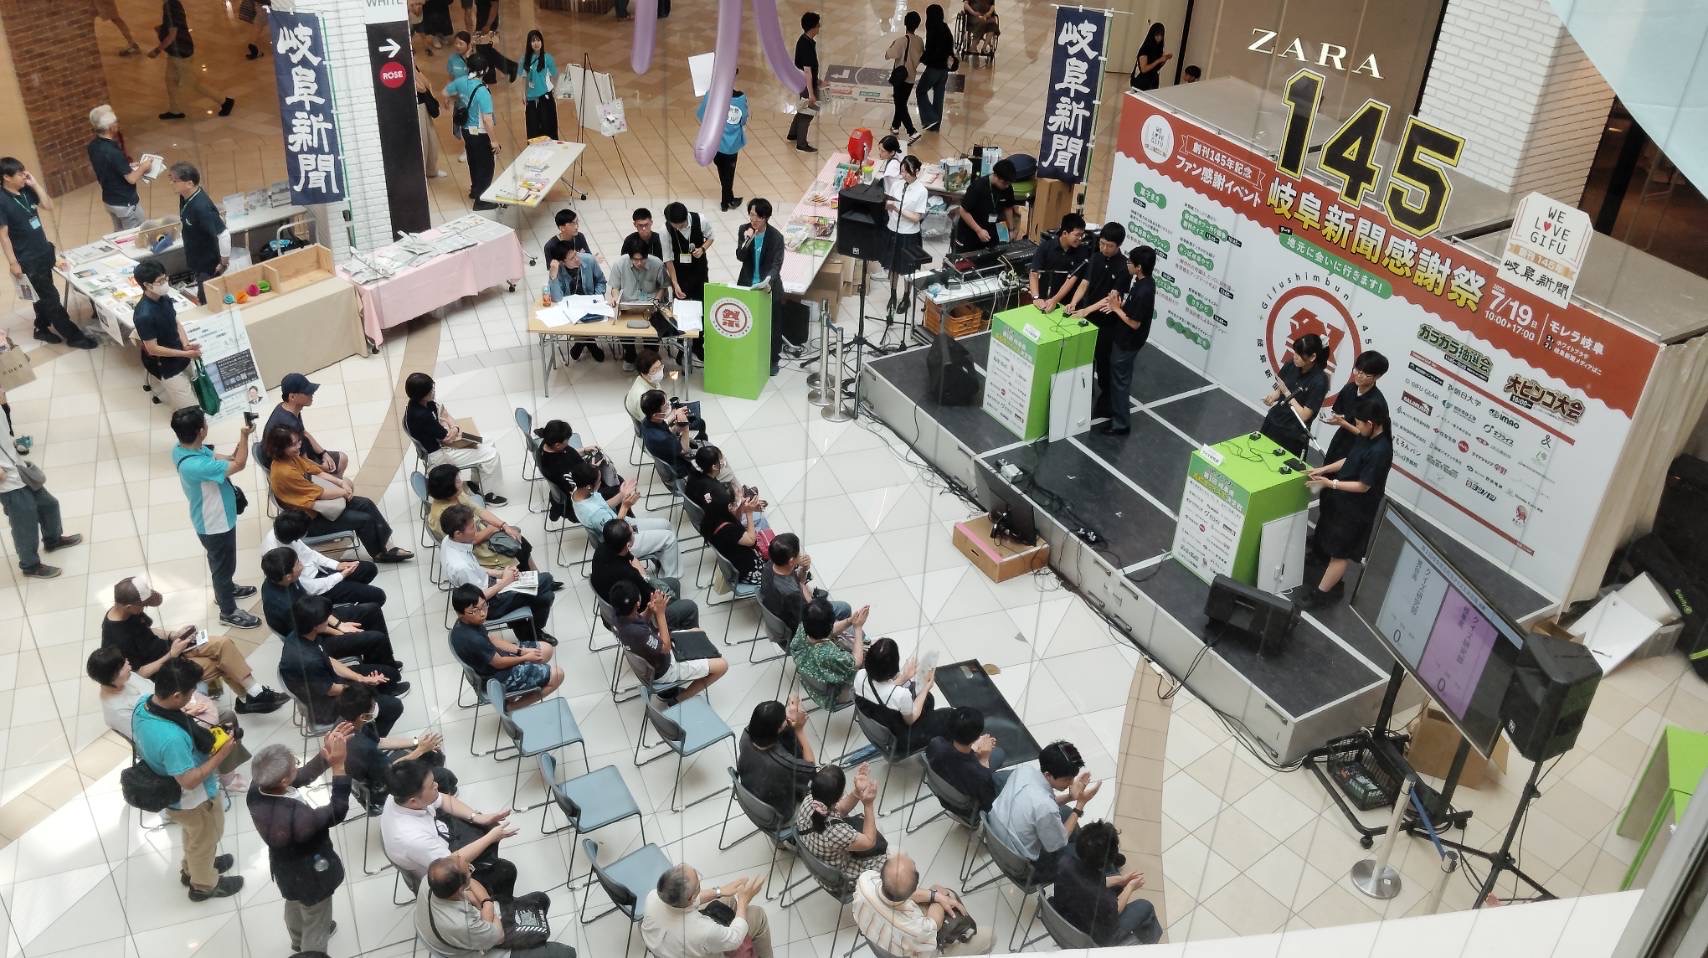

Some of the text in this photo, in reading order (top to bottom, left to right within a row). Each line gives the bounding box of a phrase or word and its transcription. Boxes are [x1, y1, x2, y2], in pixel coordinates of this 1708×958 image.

[382, 70, 404, 80] ROSE
[1247, 28, 1385, 80] ZARA
[276, 22, 340, 194] 岐阜新聞
[1041, 19, 1099, 177] 岐阜新聞
[1192, 142, 1253, 179] 創刊145年記念
[1276, 67, 1467, 239] 145
[1175, 155, 1261, 208] ファン感謝イベント
[1547, 206, 1567, 224] WE
[1266, 177, 1486, 313] 岐阜新聞感謝祭
[1530, 231, 1566, 255] GIFU
[1503, 259, 1570, 300] 岐阜新聞
[1549, 320, 1605, 356] モレラ岐阜
